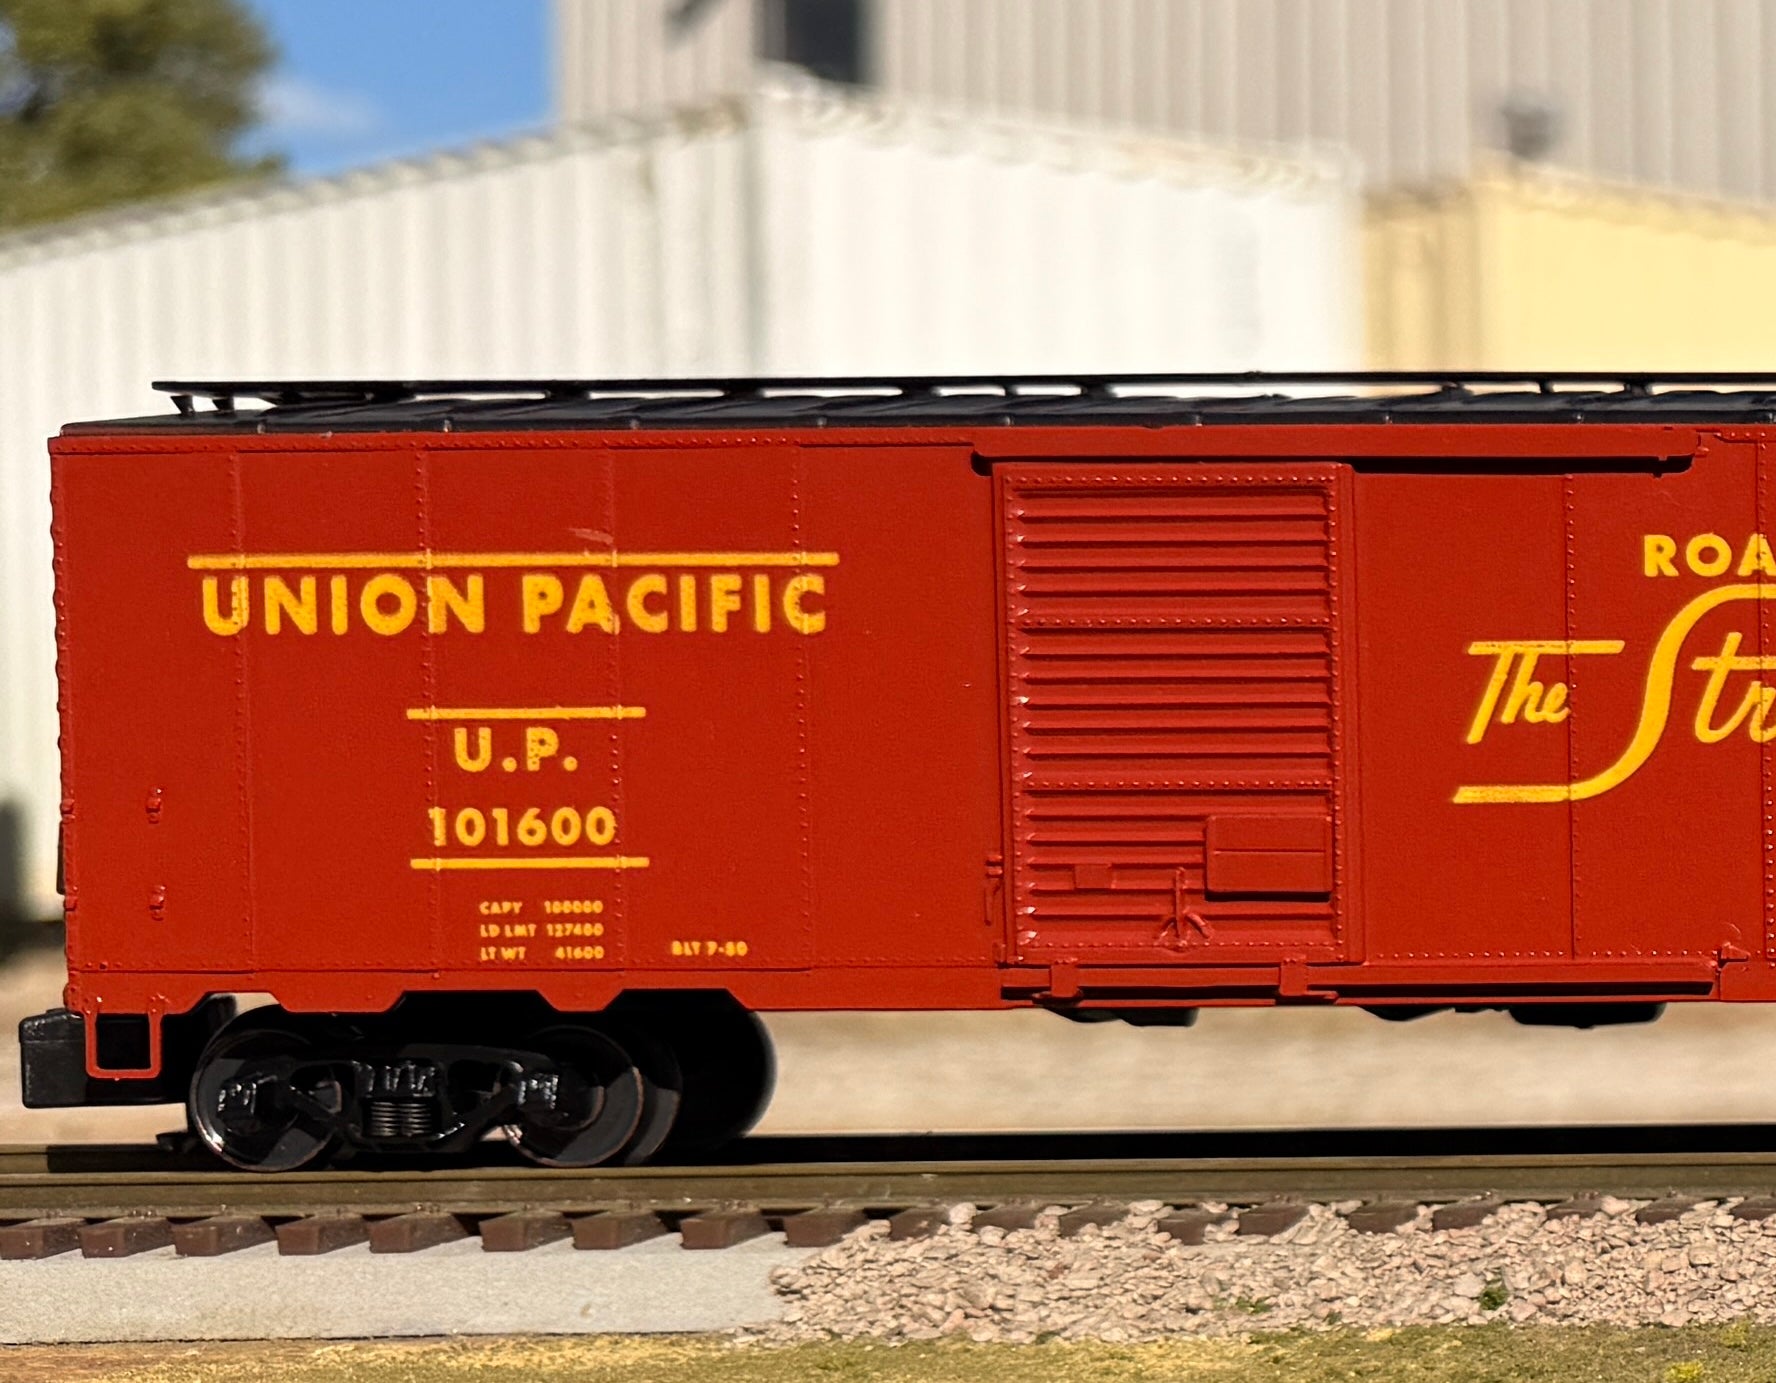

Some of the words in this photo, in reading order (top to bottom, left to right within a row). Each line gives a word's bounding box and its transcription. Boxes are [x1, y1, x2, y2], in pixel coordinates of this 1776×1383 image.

[201, 573, 486, 637] UNION
[521, 572, 826, 636] PACIFIC
[1464, 640, 1626, 745] The
[453, 726, 579, 773] U.P.
[427, 805, 618, 847] 101600
[479, 923, 500, 938] LD
[504, 923, 537, 938] LMT
[479, 946, 496, 961] LT
[501, 946, 527, 961] WT
[554, 945, 605, 960] 41600
